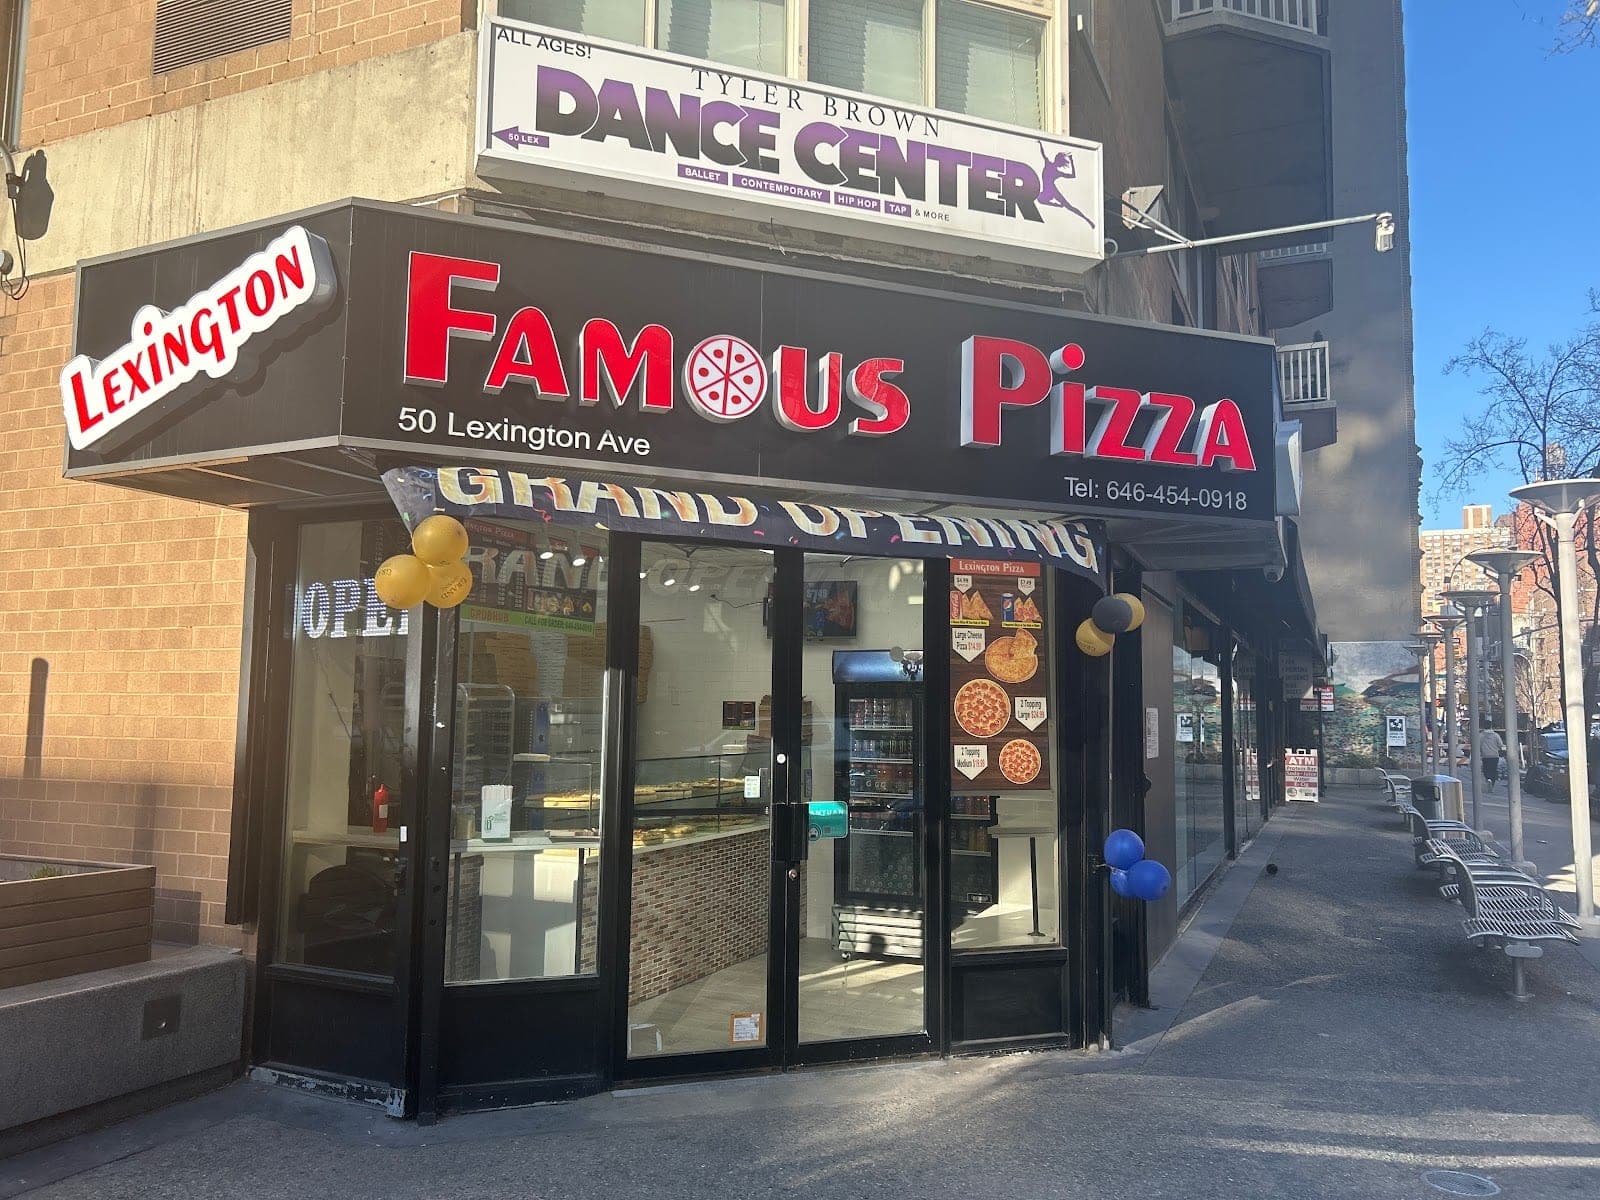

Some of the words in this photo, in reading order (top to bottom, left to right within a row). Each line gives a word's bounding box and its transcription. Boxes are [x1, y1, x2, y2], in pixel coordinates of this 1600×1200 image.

[497, 27, 532, 47] ALL
[536, 36, 592, 59] AGES!
[691, 67, 803, 110] TYLER
[823, 96, 940, 138] BROWN
[508, 133, 520, 143] 50
[521, 134, 540, 145] LEX
[535, 64, 781, 175] DANCE
[793, 121, 1045, 224] CENTER
[685, 168, 721, 182] BALLET
[740, 177, 823, 200] CONTEMPORARY
[837, 194, 855, 206] HIP
[856, 198, 878, 209] HOP
[889, 204, 907, 214] TAP
[914, 208, 921, 217] &
[923, 210, 950, 222] MORE
[398, 407, 438, 434] 50
[447, 411, 591, 453] Lexington
[599, 432, 652, 457] Ave
[1064, 476, 1100, 500] Tel:
[1105, 480, 1248, 511] 646-454-0918
[301, 577, 409, 639] OPE
[1288, 756, 1315, 766] ATM
